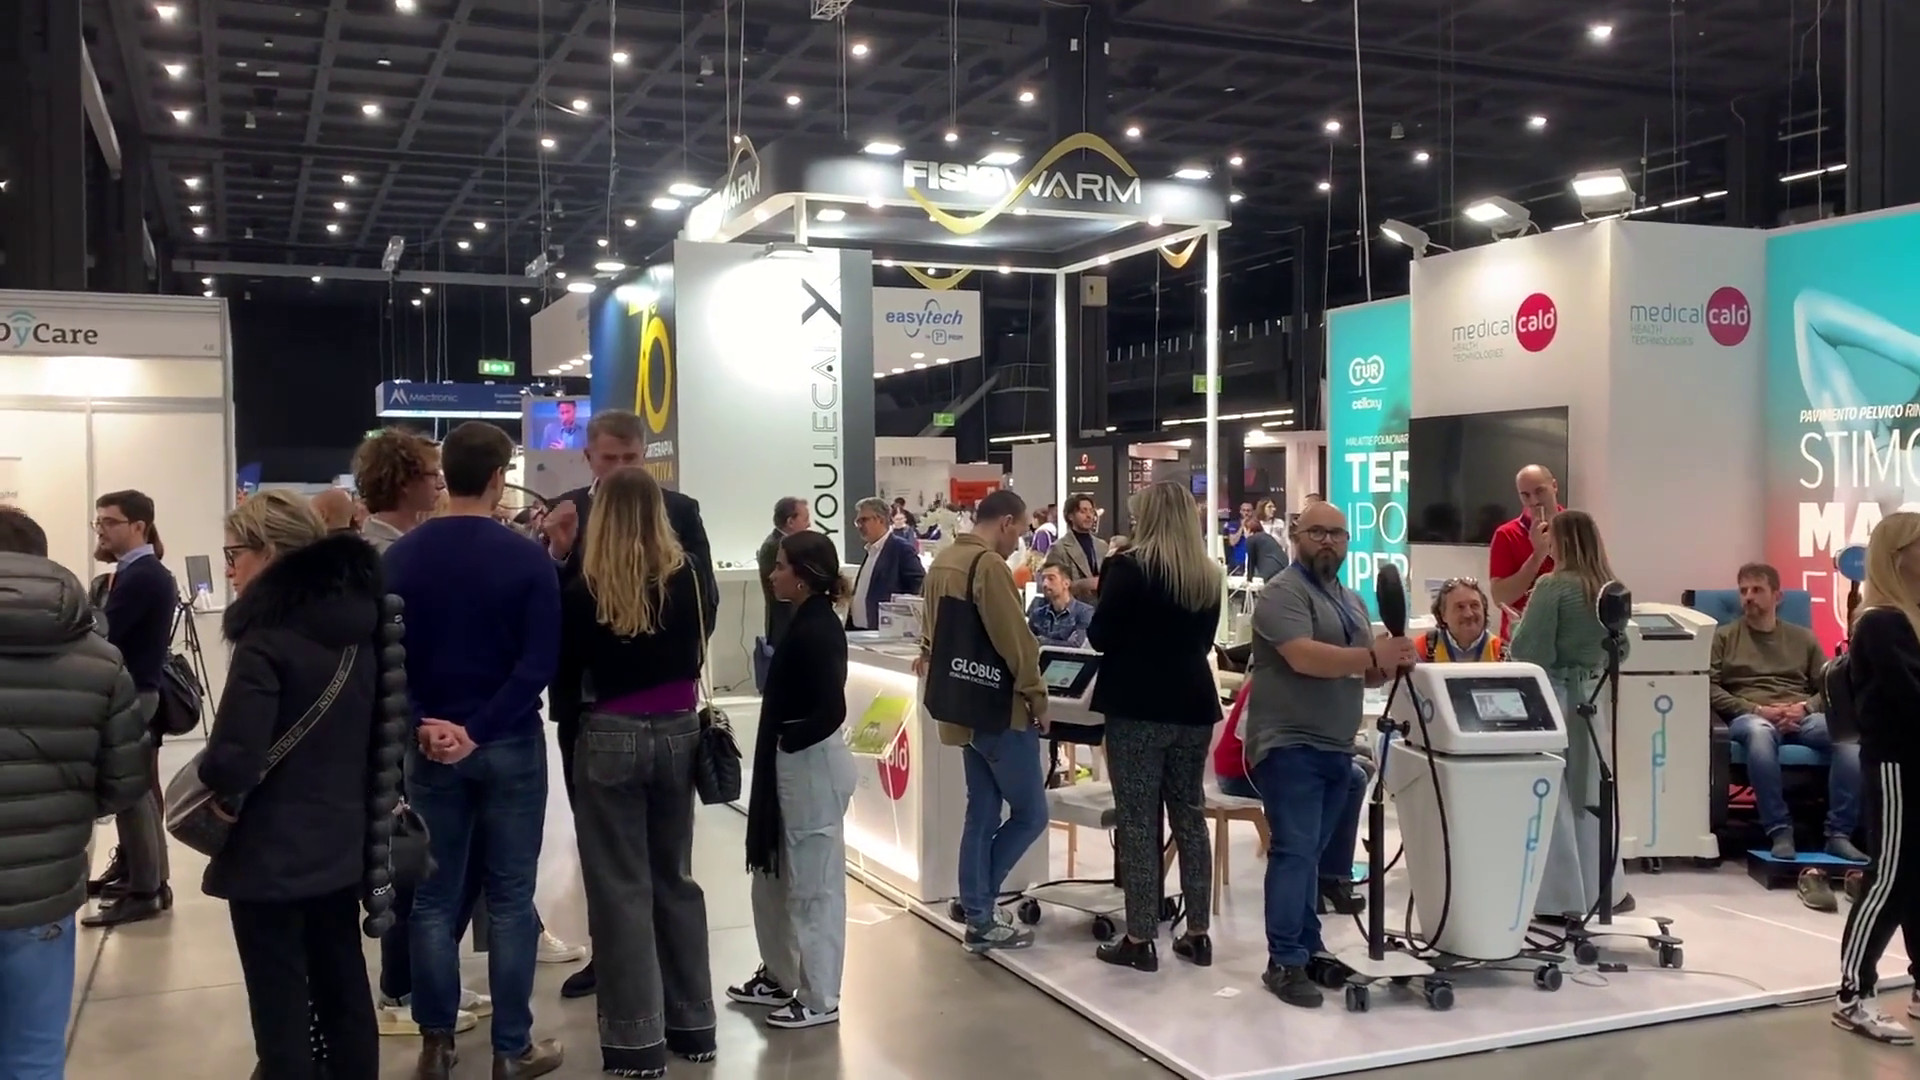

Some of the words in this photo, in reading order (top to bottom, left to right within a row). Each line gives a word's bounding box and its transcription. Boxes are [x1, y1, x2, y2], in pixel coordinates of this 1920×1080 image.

[886, 310, 963, 326] easytech
[1630, 302, 1704, 324] medical
[1452, 314, 1514, 342] medical
[1354, 363, 1379, 380] TUR
[409, 393, 459, 402] Mectronic
[1800, 407, 1857, 423] PAVIMENTO
[1859, 404, 1903, 419] PELVICO
[951, 657, 1001, 682] GLOBUS
